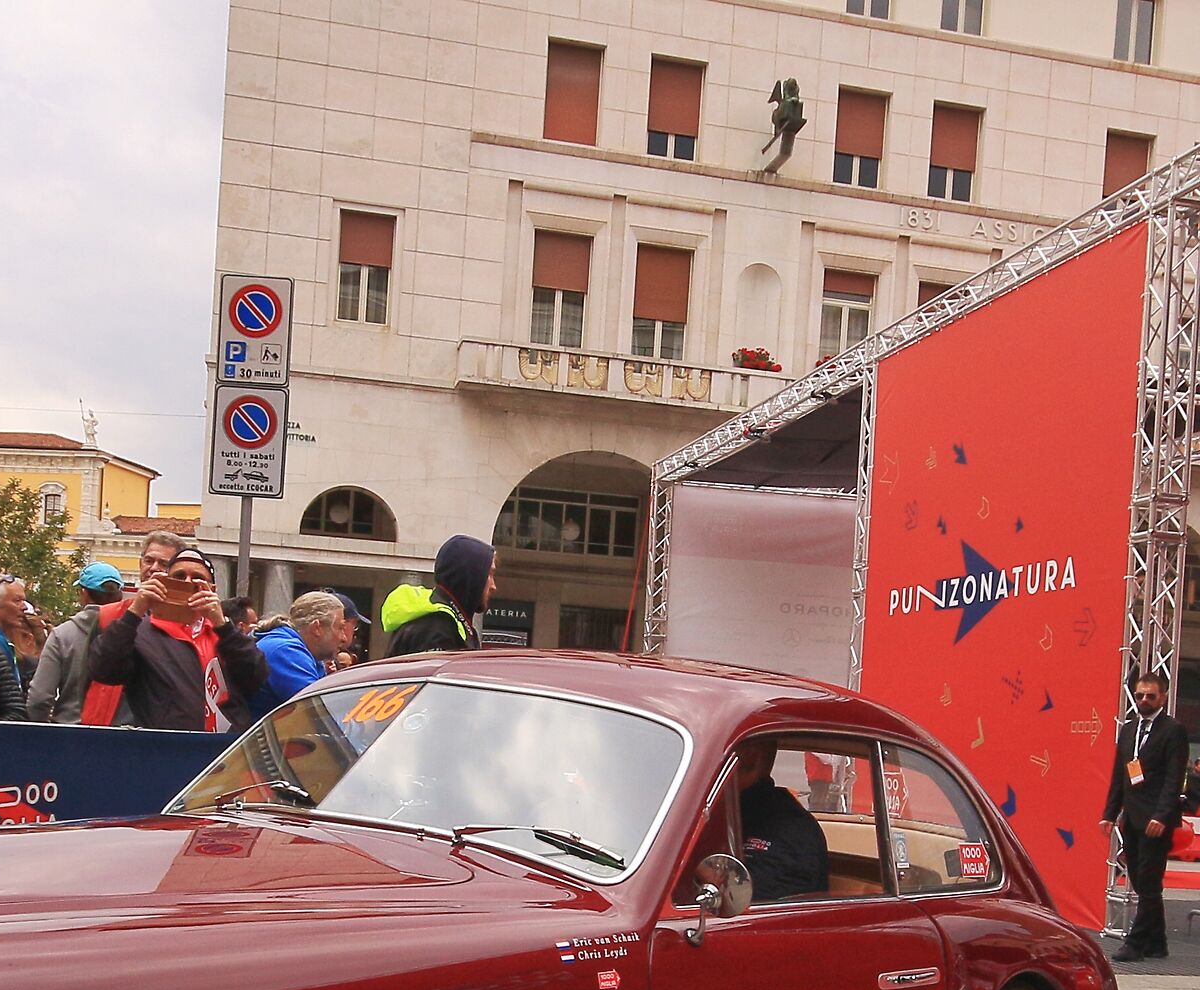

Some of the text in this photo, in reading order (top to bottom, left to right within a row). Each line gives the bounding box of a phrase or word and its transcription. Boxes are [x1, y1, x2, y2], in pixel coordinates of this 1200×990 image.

[900, 206, 942, 232] 1831
[229, 343, 242, 360] P
[239, 368, 281, 378] 30 minuti
[286, 433, 317, 442] ITTORIA
[221, 451, 240, 459] tutti
[250, 453, 275, 461] sabati
[246, 484, 274, 492] ECOCAR
[889, 556, 1076, 616] PUNZONATURA
[342, 684, 418, 724] 166
[962, 847, 982, 859] 1000
[962, 862, 985, 874] MIGLIA
[573, 932, 640, 947] Eric van Schaik
[578, 946, 628, 960] Chris Leyds
